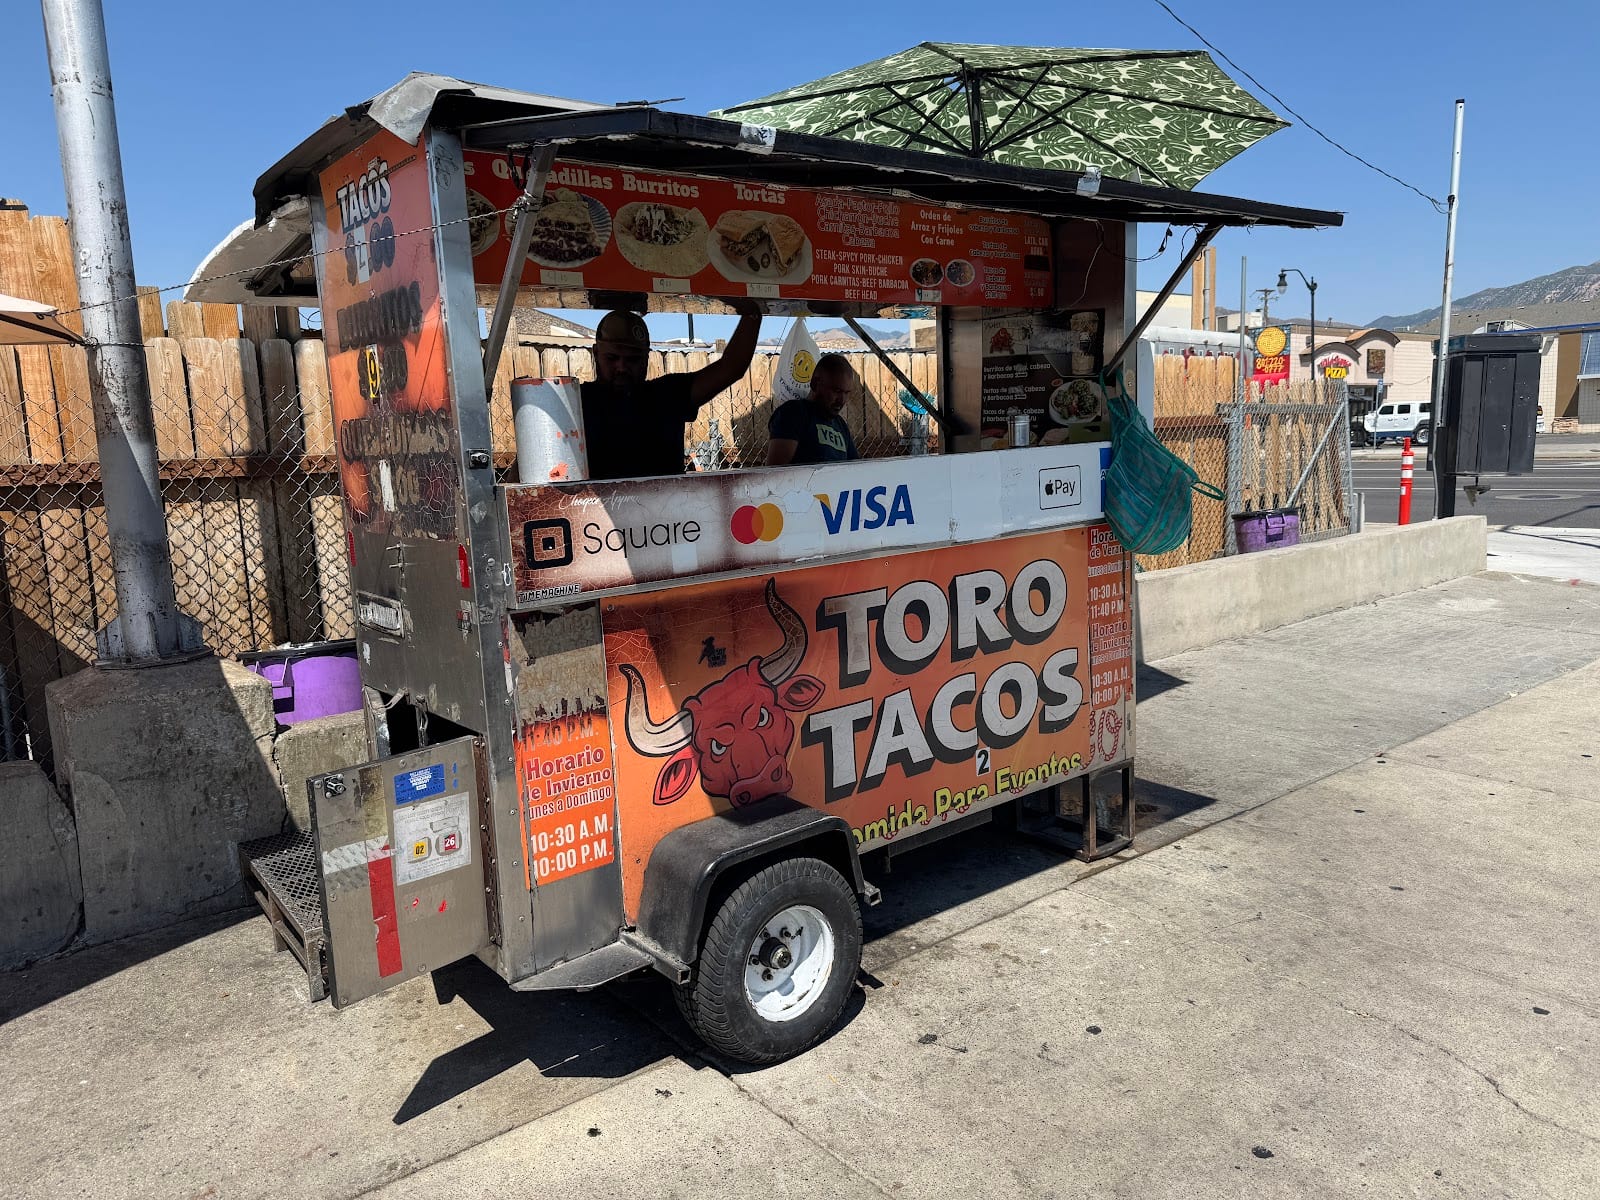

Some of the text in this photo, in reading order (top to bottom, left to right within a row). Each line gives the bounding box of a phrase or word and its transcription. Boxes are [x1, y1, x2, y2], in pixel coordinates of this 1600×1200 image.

[492, 158, 613, 190] Quadillas
[622, 174, 699, 198] Burritos
[734, 183, 786, 204] Tortas
[337, 160, 391, 233] TACOS
[920, 209, 952, 221] Orden de
[911, 220, 931, 231] Arroz
[938, 224, 964, 236] Frijoles
[921, 234, 955, 246] Con Carne
[860, 252, 903, 265] PORK-CHICKEN
[834, 263, 888, 276] PORK SKIN-BUCHE
[811, 275, 909, 290] PORK CARNITAS-BEEF BARBACOA
[844, 289, 878, 300] BEEF HEAD
[1325, 367, 1347, 378] PIZZA
[822, 428, 843, 447] YETI
[1054, 479, 1076, 497] Pay
[814, 484, 915, 536] VISA
[583, 520, 701, 558] Square
[1091, 528, 1118, 545] Hora
[1090, 546, 1100, 559] de
[1090, 584, 1110, 601] 10:30
[1091, 602, 1110, 619] 11:40
[819, 559, 1067, 682] TORO
[1091, 617, 1128, 639] Horario
[1099, 635, 1131, 651] Invierno
[1092, 666, 1130, 688] 10:30 A.M.
[1093, 687, 1112, 705] 10:00
[805, 648, 1083, 796] TACOS
[526, 744, 605, 781] Horario
[977, 749, 990, 776] 2
[546, 768, 612, 796] Invierno
[528, 786, 612, 820] unes a Domingo
[852, 752, 1082, 846] omida Para Eventos
[445, 837, 455, 847] 26
[531, 813, 613, 854] 10:30 A.M.
[415, 845, 424, 855] 02
[533, 838, 612, 880] 10:00 P.M.
